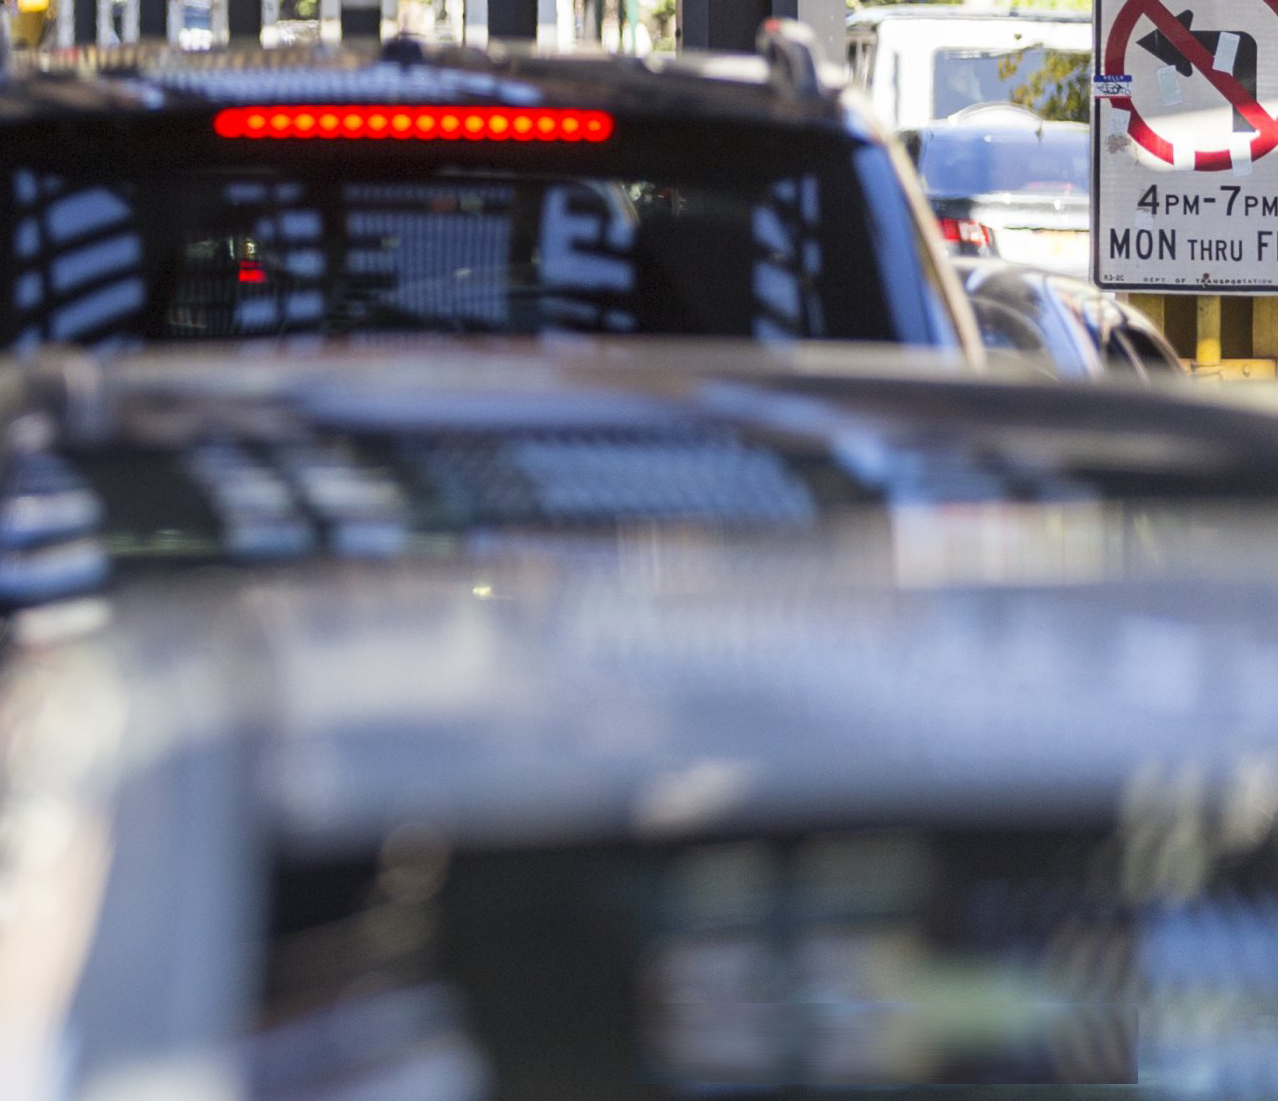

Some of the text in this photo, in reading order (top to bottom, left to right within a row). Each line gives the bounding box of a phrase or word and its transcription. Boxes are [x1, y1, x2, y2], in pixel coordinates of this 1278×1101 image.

[1137, 184, 1278, 217] 4PM-7PM
[1109, 228, 1278, 261] MON THRU F
